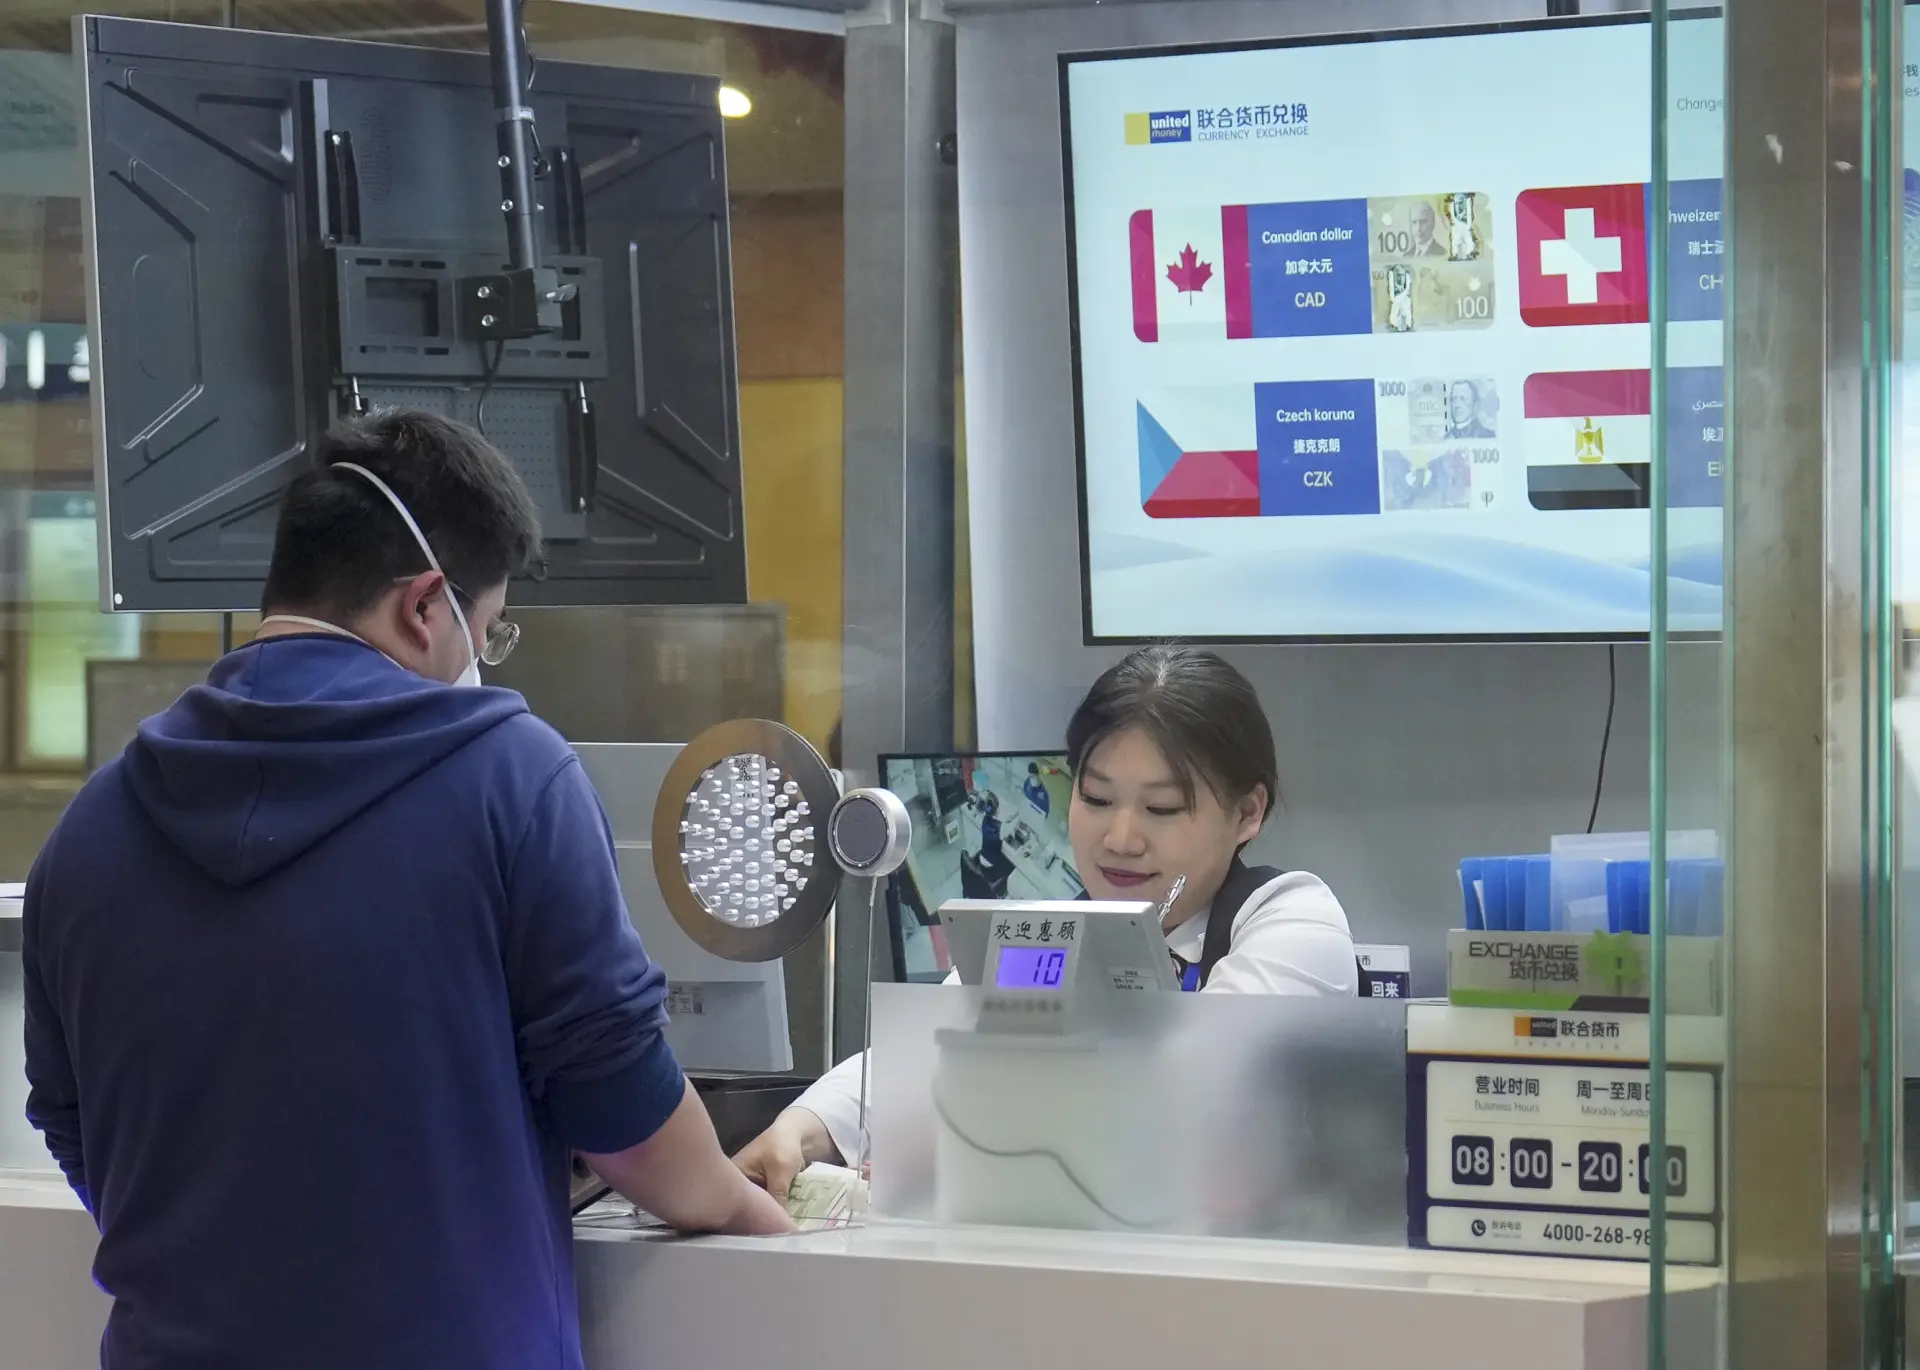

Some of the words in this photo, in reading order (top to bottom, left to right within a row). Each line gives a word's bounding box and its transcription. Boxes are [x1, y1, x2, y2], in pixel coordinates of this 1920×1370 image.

[1151, 113, 1190, 129] united
[1197, 103, 1308, 129] 联合货币兑换
[1151, 127, 1182, 138] money
[1198, 129, 1250, 141] CURRENCY
[1256, 125, 1309, 138] EXCHANGE
[1261, 230, 1318, 244] Canadian
[1321, 226, 1353, 241] dollar
[1378, 231, 1409, 253] 100
[1285, 258, 1333, 275] 加拿大元
[1295, 291, 1325, 308] CAD
[1456, 296, 1489, 319] 100
[1379, 381, 1406, 397] 1000
[1276, 409, 1312, 422] Czech
[1314, 408, 1355, 420] koruna
[1293, 438, 1341, 454] 捷克克朗
[1472, 448, 1500, 464] 1000
[1707, 461, 1724, 477] E
[1303, 471, 1333, 487] CZK
[994, 918, 1077, 942] 欢迎惠顾
[1469, 941, 1579, 960] EXCHANGE
[1033, 953, 1065, 986] 10
[1509, 959, 1579, 982] 货币兑换
[1371, 980, 1400, 998] 回来
[1561, 1020, 1620, 1038] 联合货币
[1475, 1075, 1540, 1097] 营业时间
[1474, 1100, 1512, 1112] Business
[1514, 1101, 1540, 1113] Hours
